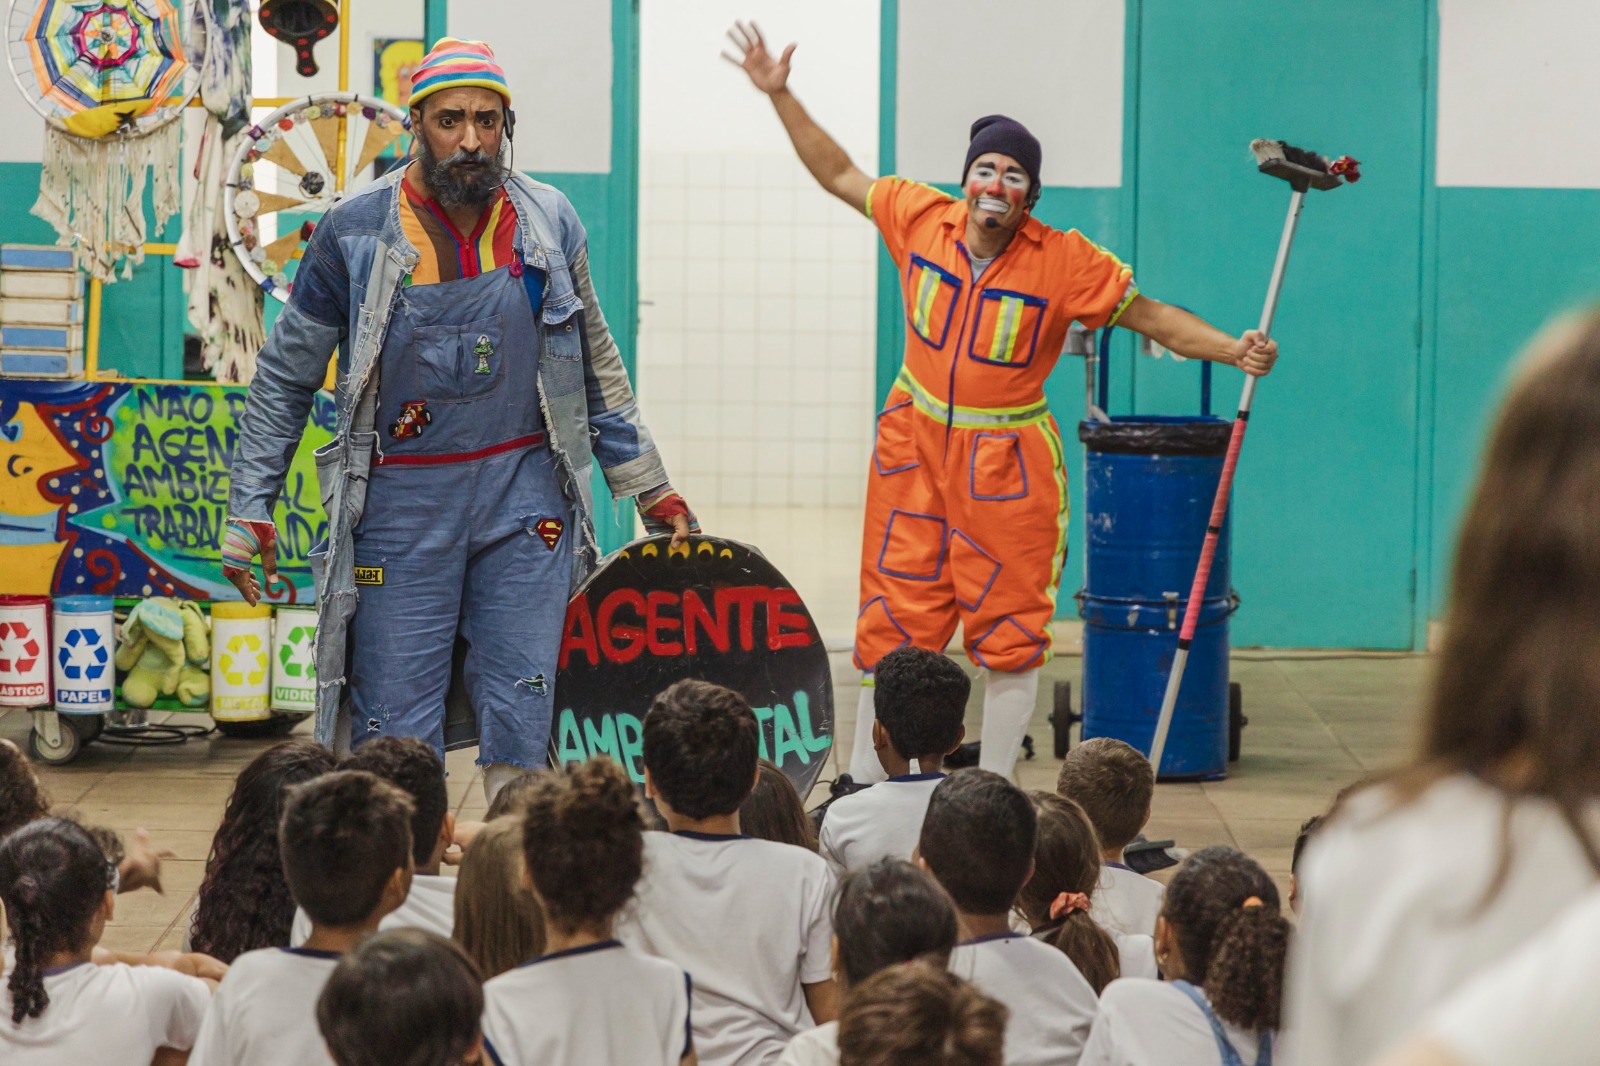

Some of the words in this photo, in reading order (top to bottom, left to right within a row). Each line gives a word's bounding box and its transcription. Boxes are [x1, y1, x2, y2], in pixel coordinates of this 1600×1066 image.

[137, 384, 213, 424] NÃO
[132, 423, 239, 469] AGEN
[355, 569, 381, 582] Ferr
[558, 586, 812, 669] AGENTE
[61, 691, 106, 702] PAPEL
[558, 690, 832, 784] AMBTAL
